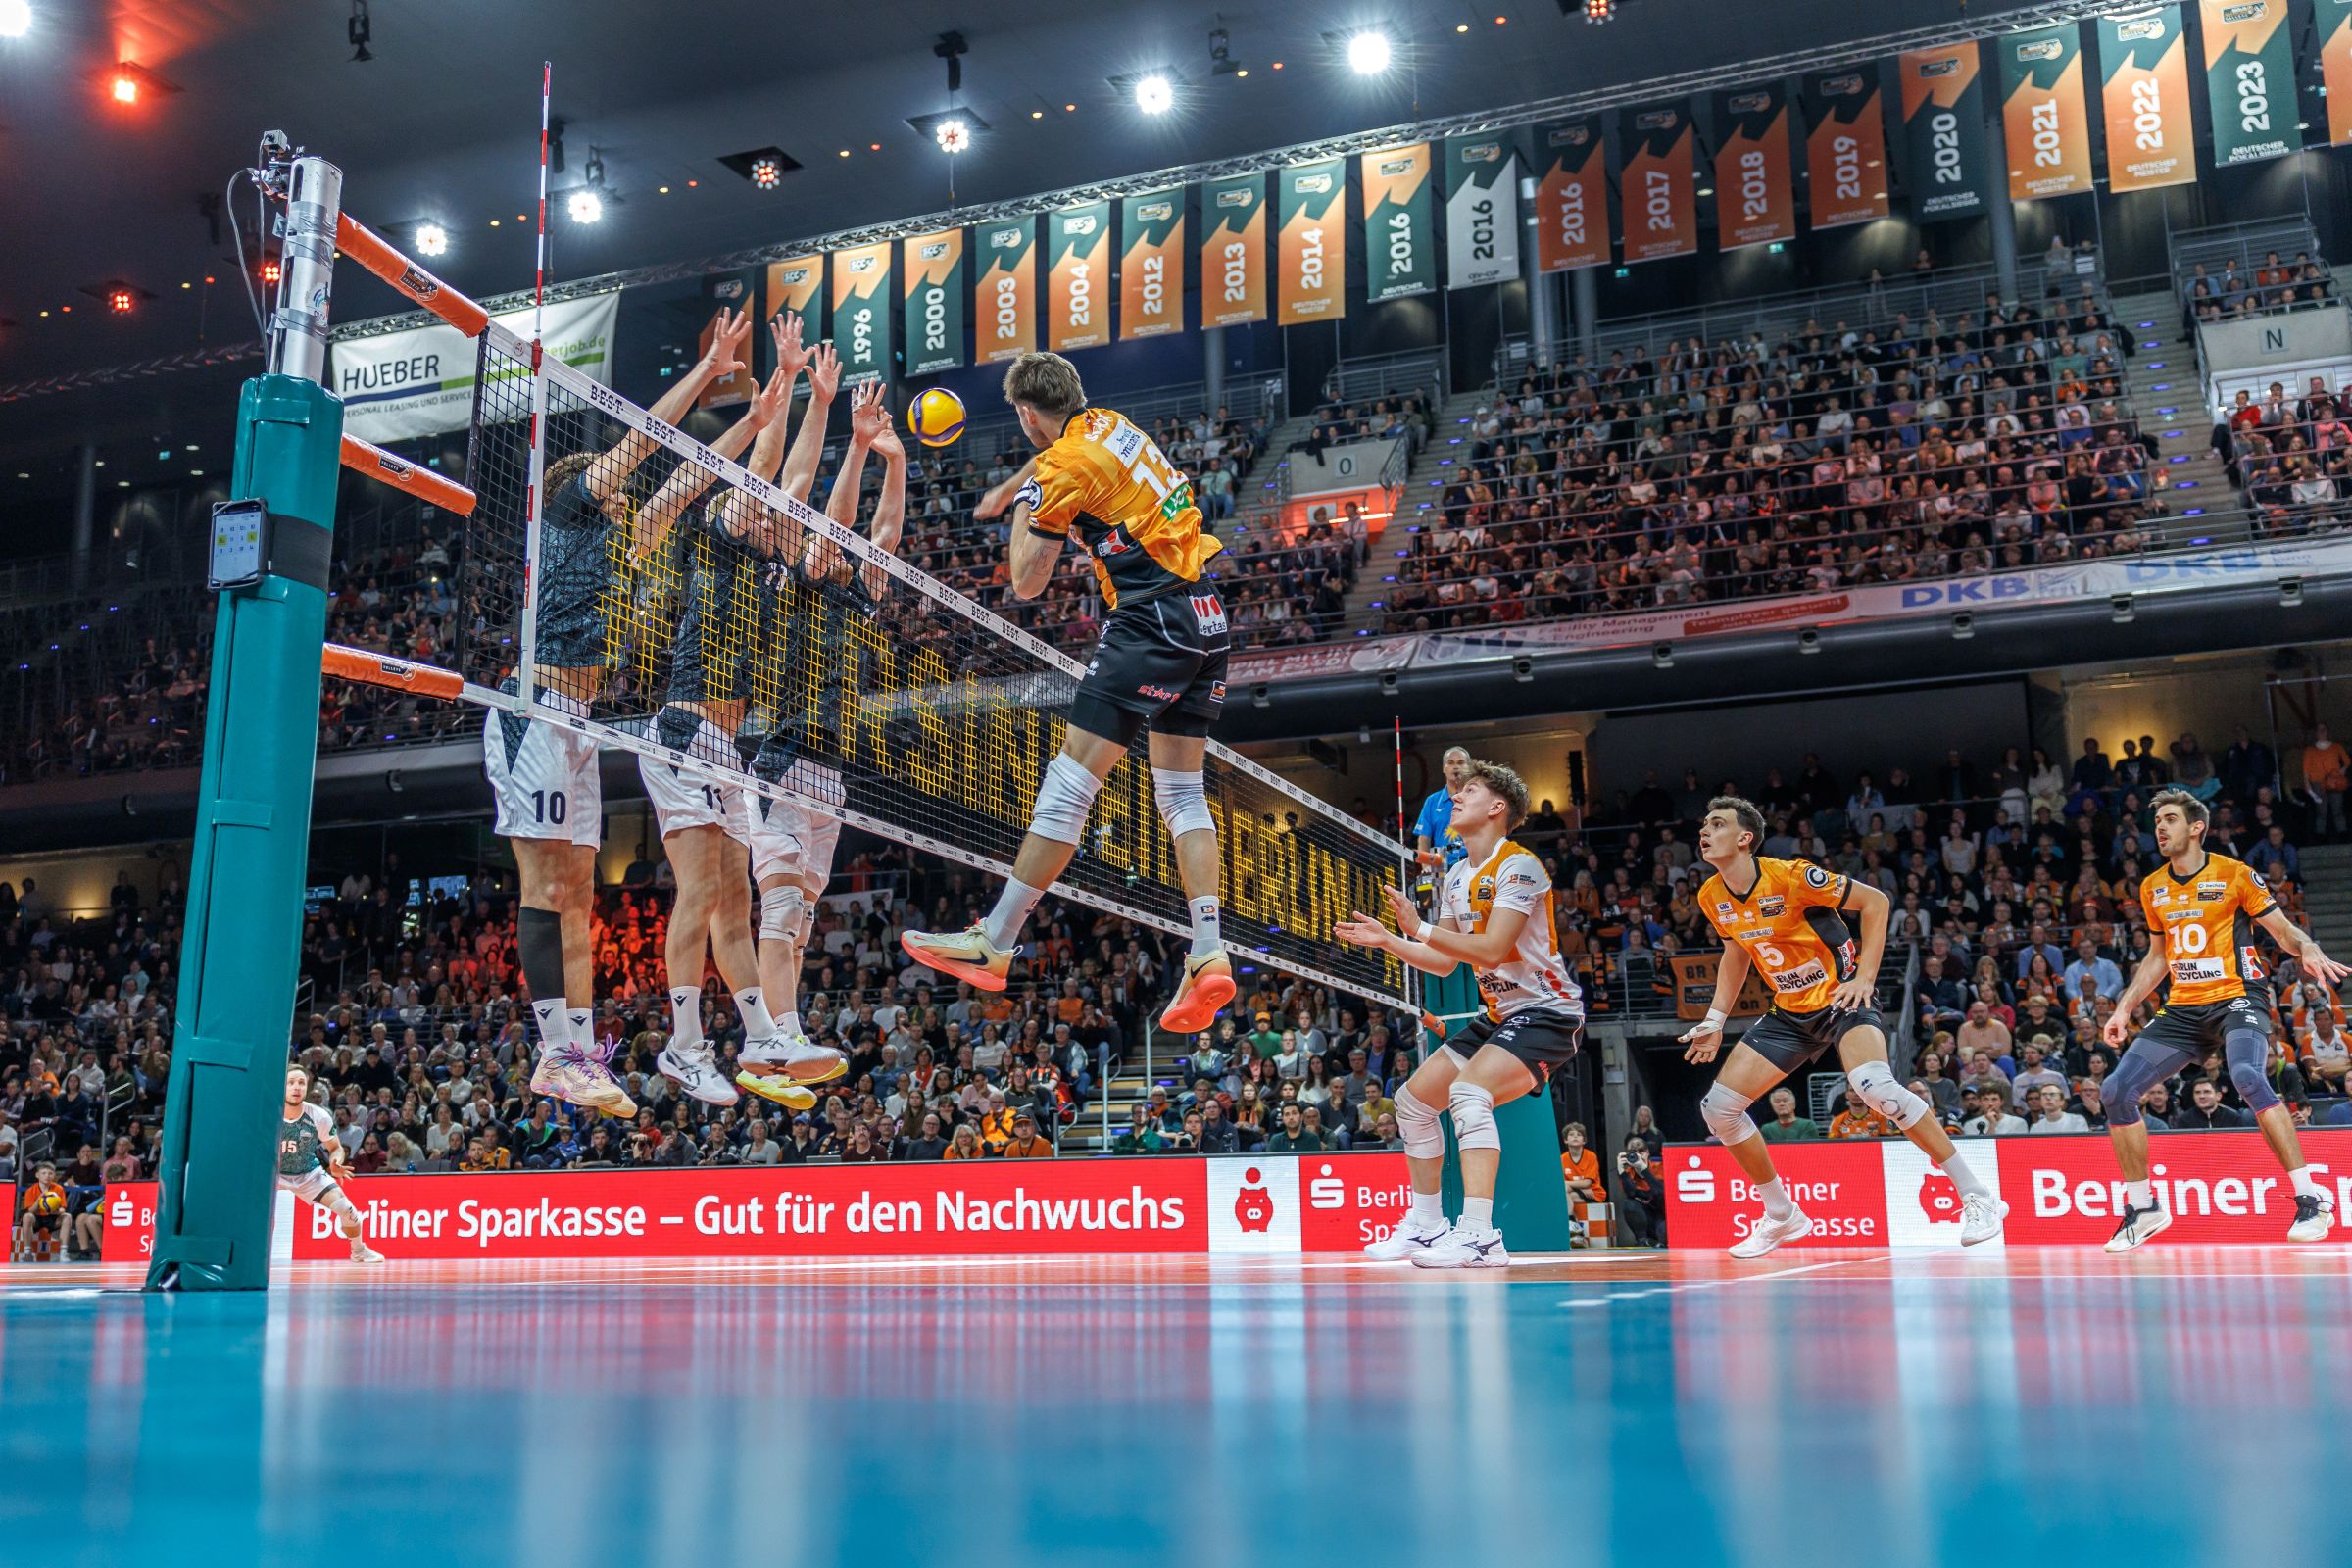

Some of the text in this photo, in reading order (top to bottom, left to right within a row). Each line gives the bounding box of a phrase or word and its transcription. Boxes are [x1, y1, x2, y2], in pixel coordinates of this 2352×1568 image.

[2132, 78, 2163, 150] 2022
[2236, 61, 2270, 133] 2023
[1932, 113, 1961, 184] 2020
[2031, 98, 2060, 168] 2021
[1740, 151, 1767, 215] 2018
[1834, 135, 1860, 200] 2019
[1472, 199, 1494, 261] 2016
[1560, 182, 1585, 245] 2016
[1646, 171, 1670, 231] 2017
[1224, 242, 1246, 302] 2013
[1301, 227, 1324, 290] 2014
[1389, 212, 1413, 275] 2016
[997, 277, 1016, 339] 2003
[1069, 264, 1090, 326] 2004
[1143, 256, 1164, 315] 2012
[853, 308, 872, 364] 1996
[925, 287, 945, 351] 2000
[2266, 328, 2283, 349] N
[344, 354, 440, 392] HUEBER
[384, 398, 419, 413] LEASING
[420, 396, 439, 407] UND
[440, 390, 472, 403] SERVICE
[1901, 575, 2029, 608] DKB
[2125, 554, 2264, 582] DKB
[1552, 624, 1654, 641] Engineering
[1602, 610, 1711, 627] Management
[531, 789, 566, 825] 10
[1754, 941, 1784, 967] 5
[2168, 923, 2207, 955] 10
[458, 1196, 647, 1247] Sparkasse
[694, 1194, 764, 1235] Gut
[775, 1190, 835, 1234] für
[846, 1190, 922, 1233] den
[936, 1185, 1185, 1232] Nachwuchs
[1731, 1179, 1840, 1203] Beiner
[2032, 1163, 2277, 1218] Beriner
[1733, 1213, 1875, 1240] Spasse
